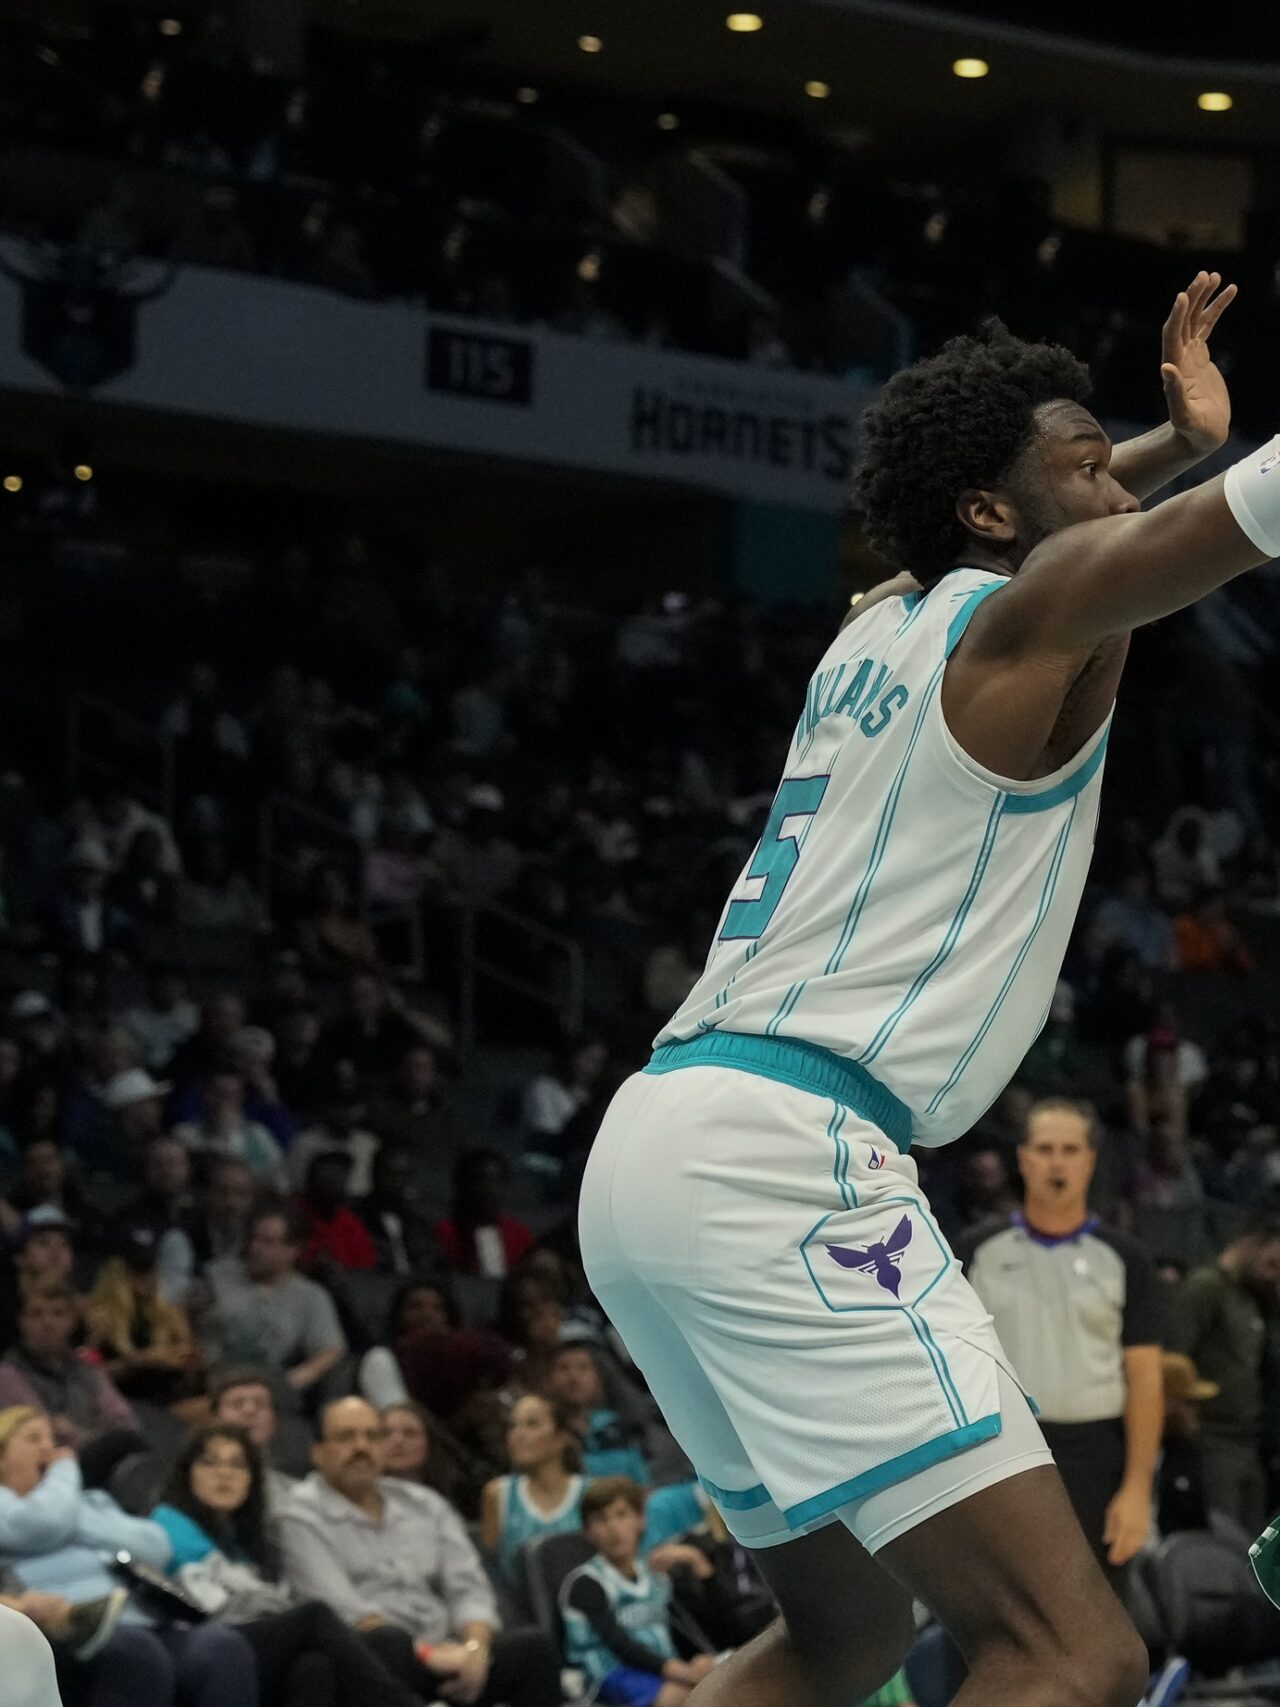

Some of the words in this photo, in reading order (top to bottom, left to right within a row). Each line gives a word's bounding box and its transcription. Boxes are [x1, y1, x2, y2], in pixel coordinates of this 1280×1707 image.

[448, 338, 512, 397] 115
[630, 383, 853, 472] HORNETS
[718, 774, 831, 941] 5
